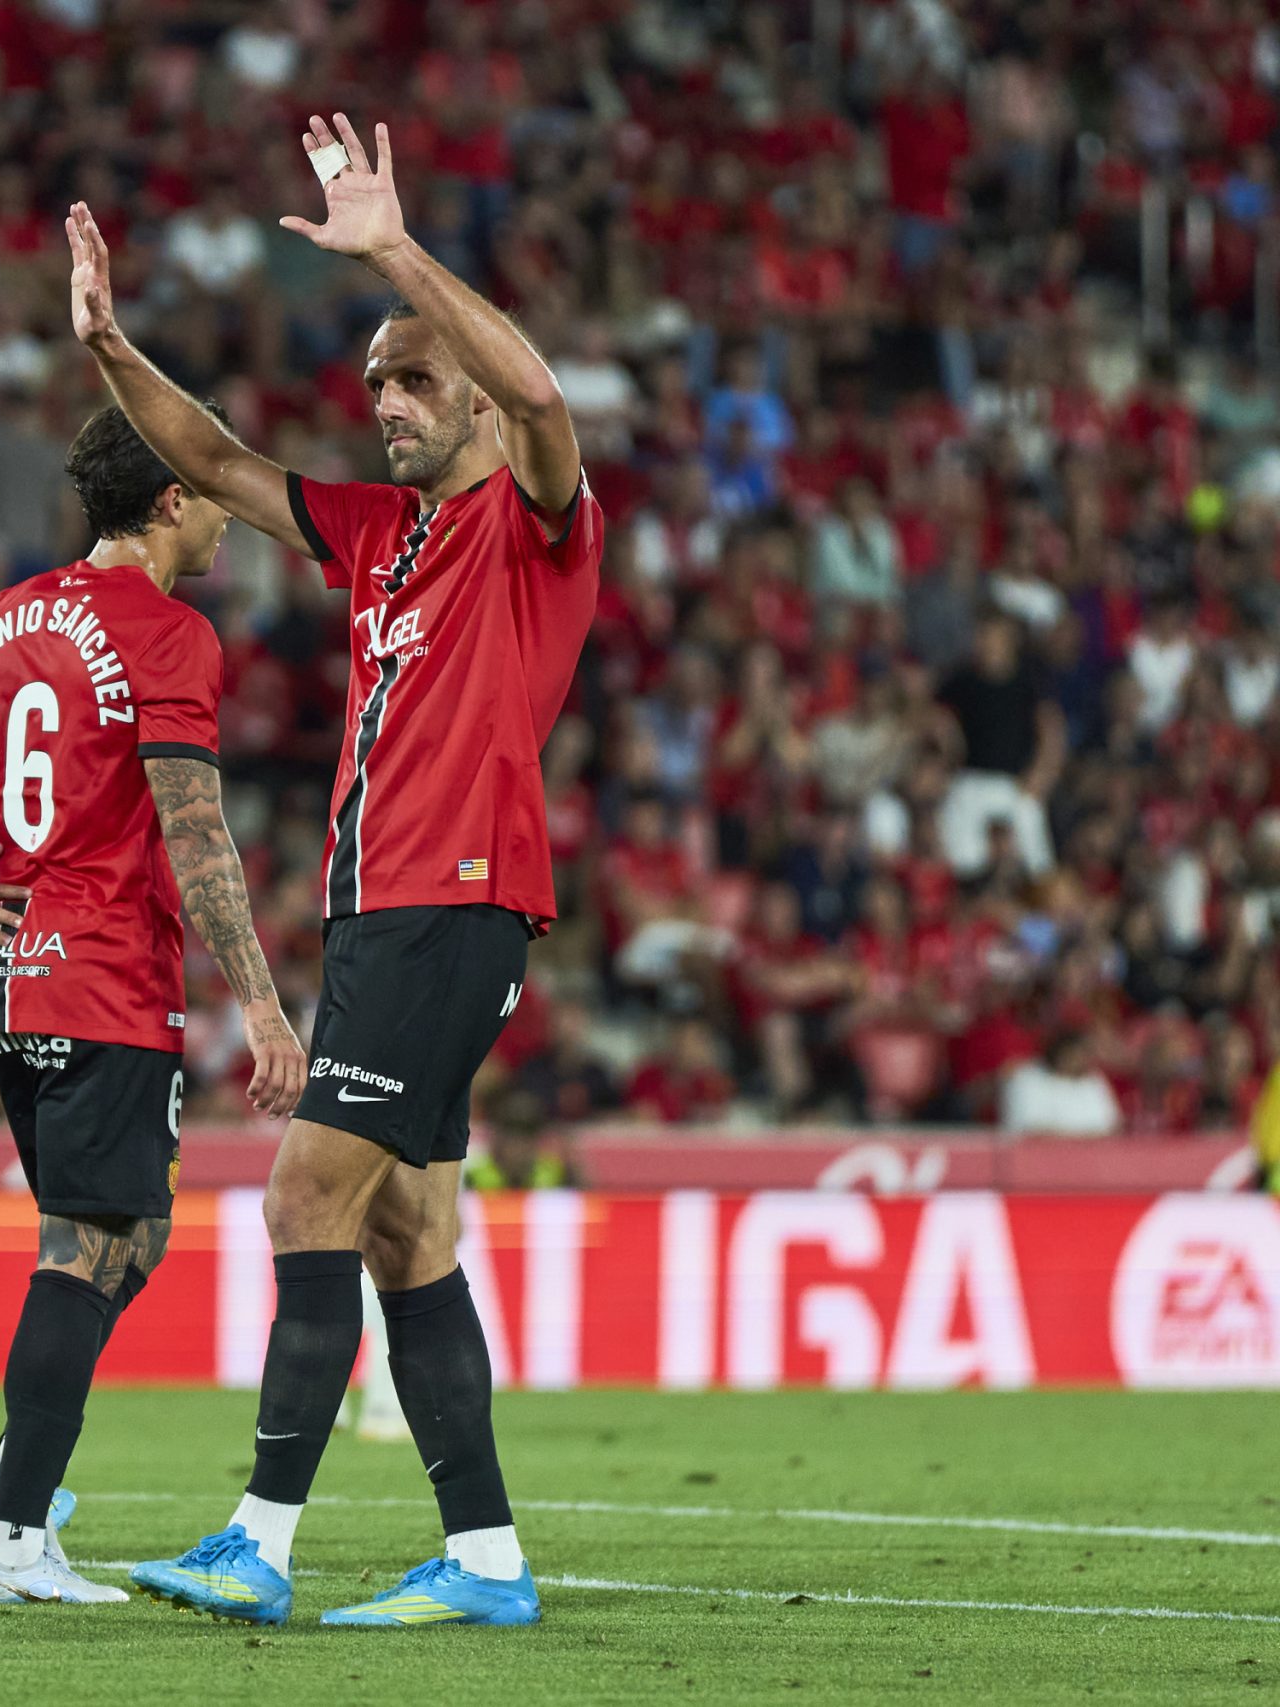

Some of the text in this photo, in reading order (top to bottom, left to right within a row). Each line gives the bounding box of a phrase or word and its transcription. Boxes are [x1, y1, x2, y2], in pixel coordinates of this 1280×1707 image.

[47, 594, 135, 728] SÁNCHEZ
[2, 681, 60, 854] 6
[16, 966, 50, 978] RESORTS
[167, 1070, 184, 1140] 6
[329, 1062, 404, 1094] AirEuropa
